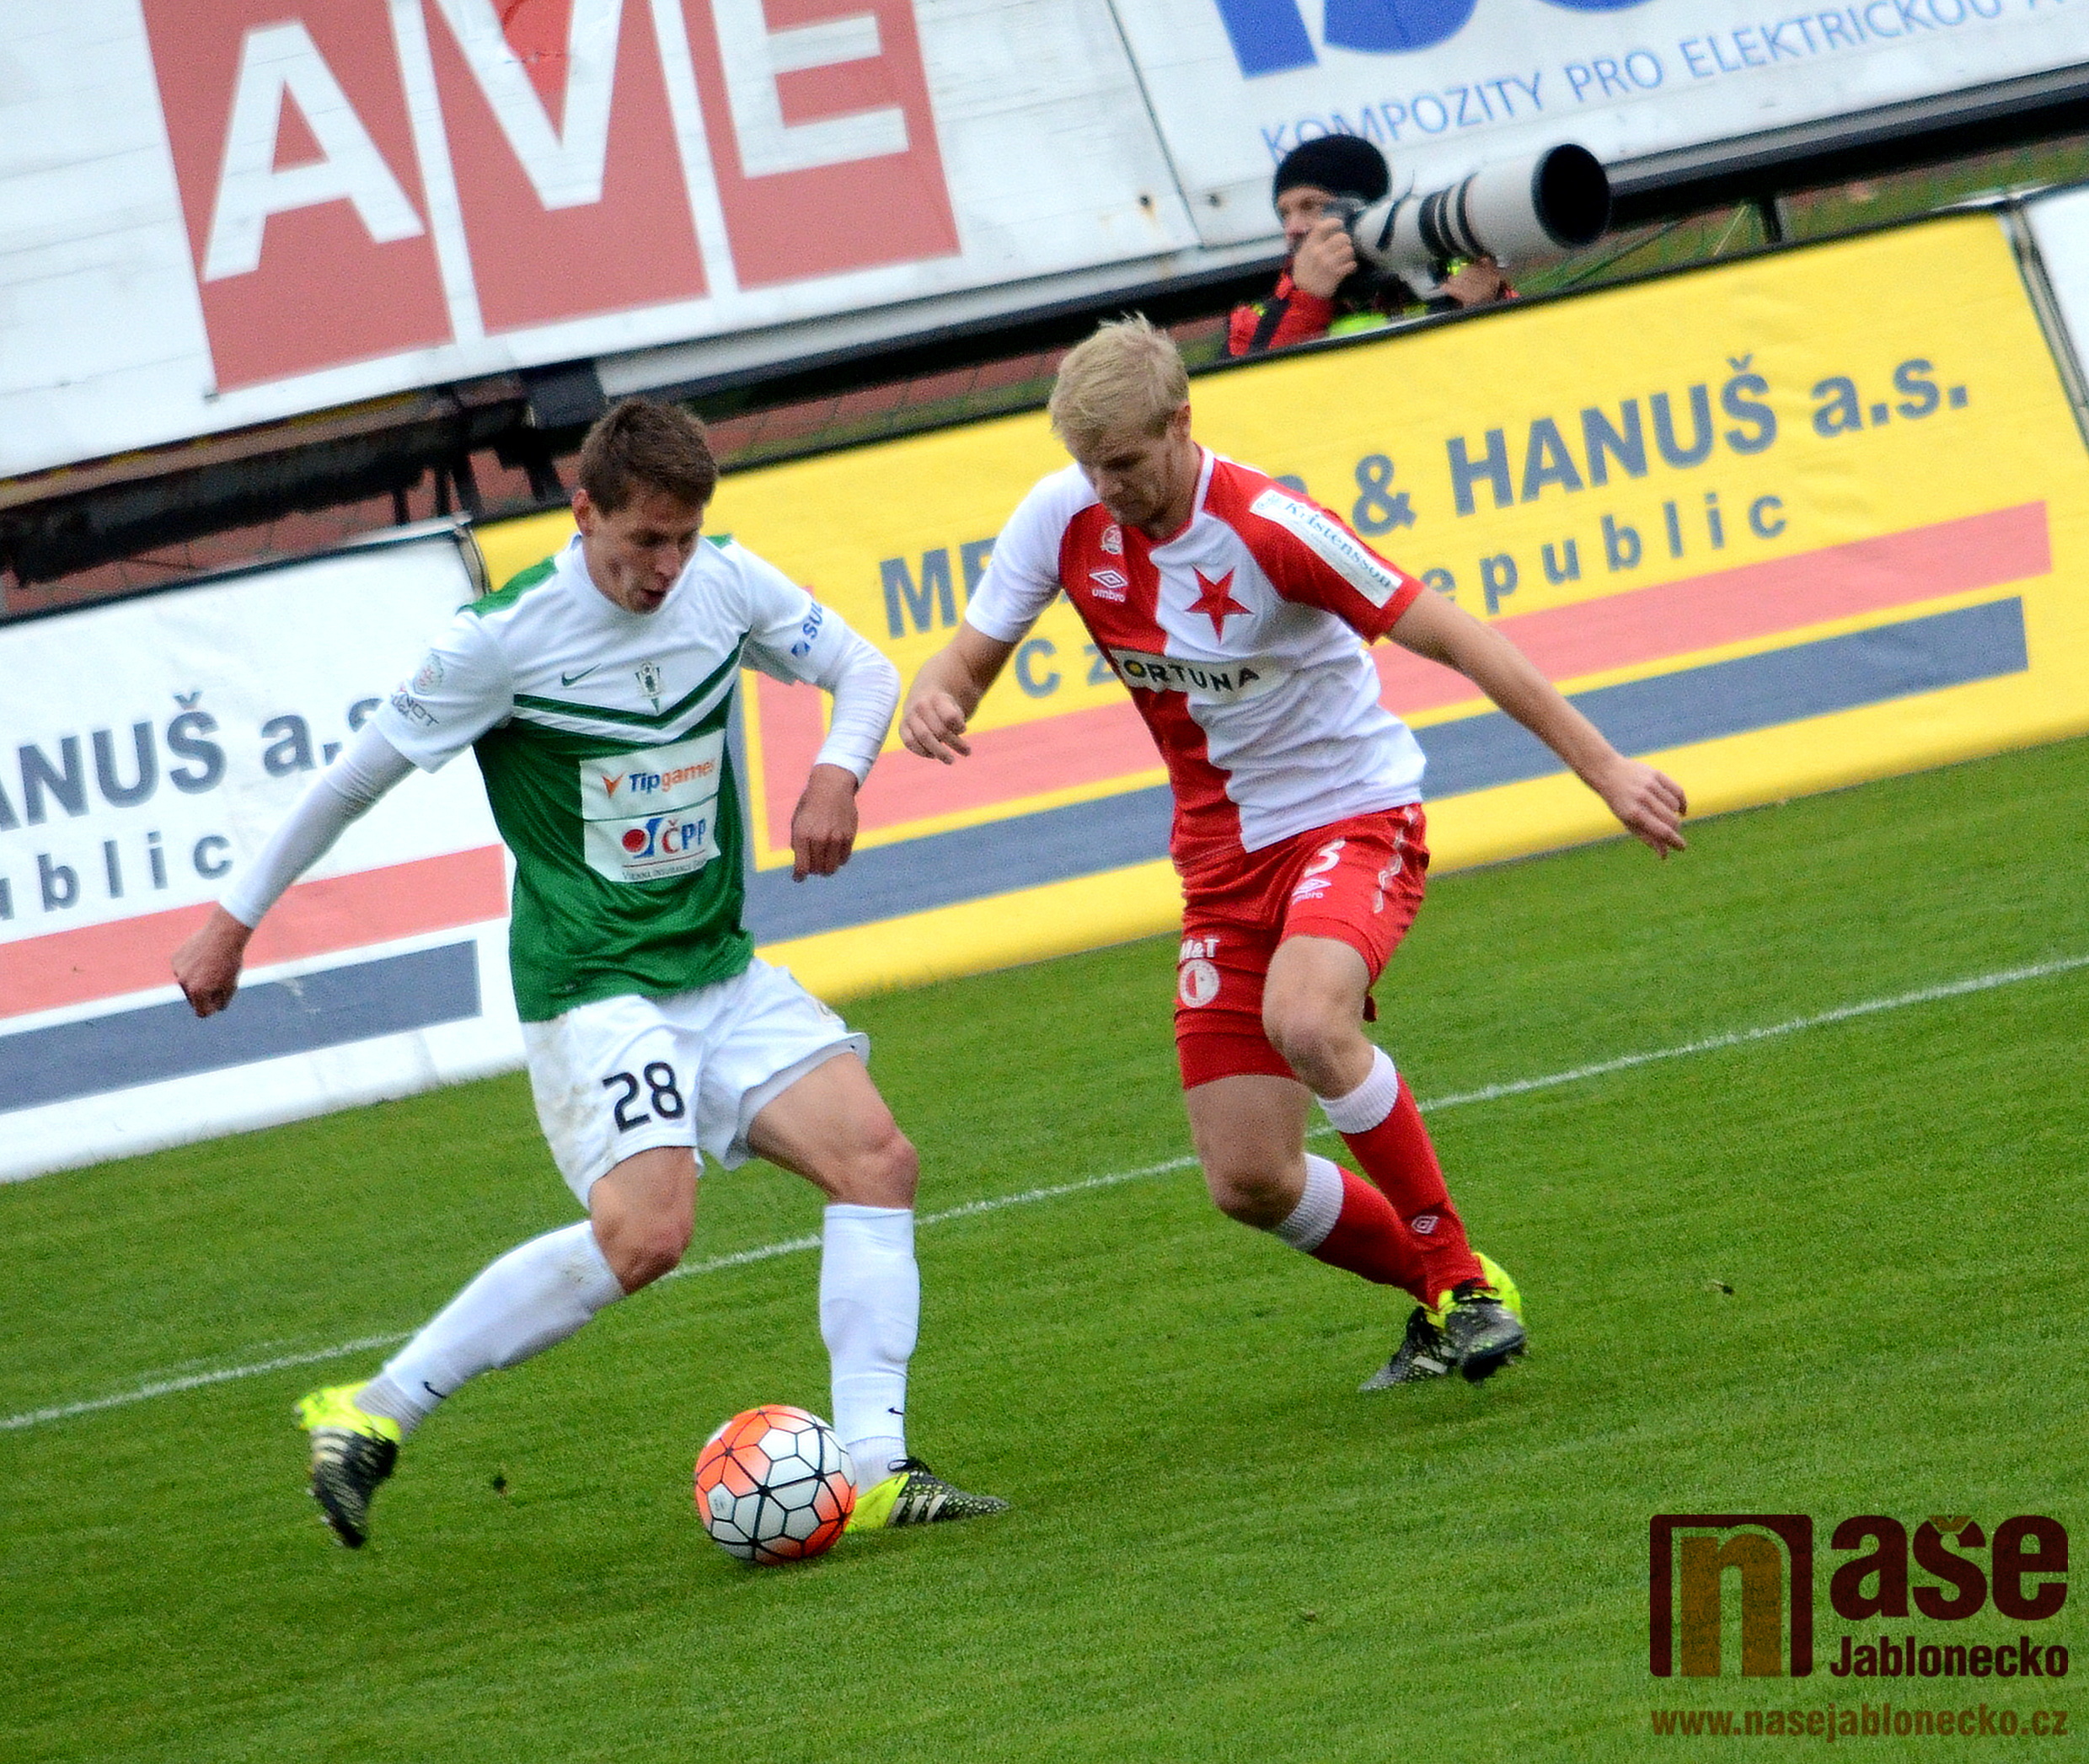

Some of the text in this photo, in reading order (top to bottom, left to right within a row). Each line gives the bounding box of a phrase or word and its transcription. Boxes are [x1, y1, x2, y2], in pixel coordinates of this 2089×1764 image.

[1563, 51, 1663, 102] PRO
[202, 0, 910, 282] AVE
[1352, 353, 1970, 538] & HANUŠ a.s.
[1422, 492, 1786, 614] epublic
[1092, 588, 1126, 603] umbro
[1122, 658, 1261, 693] ORTUNA
[661, 818, 706, 855] ČPP
[602, 1060, 685, 1134] 28
